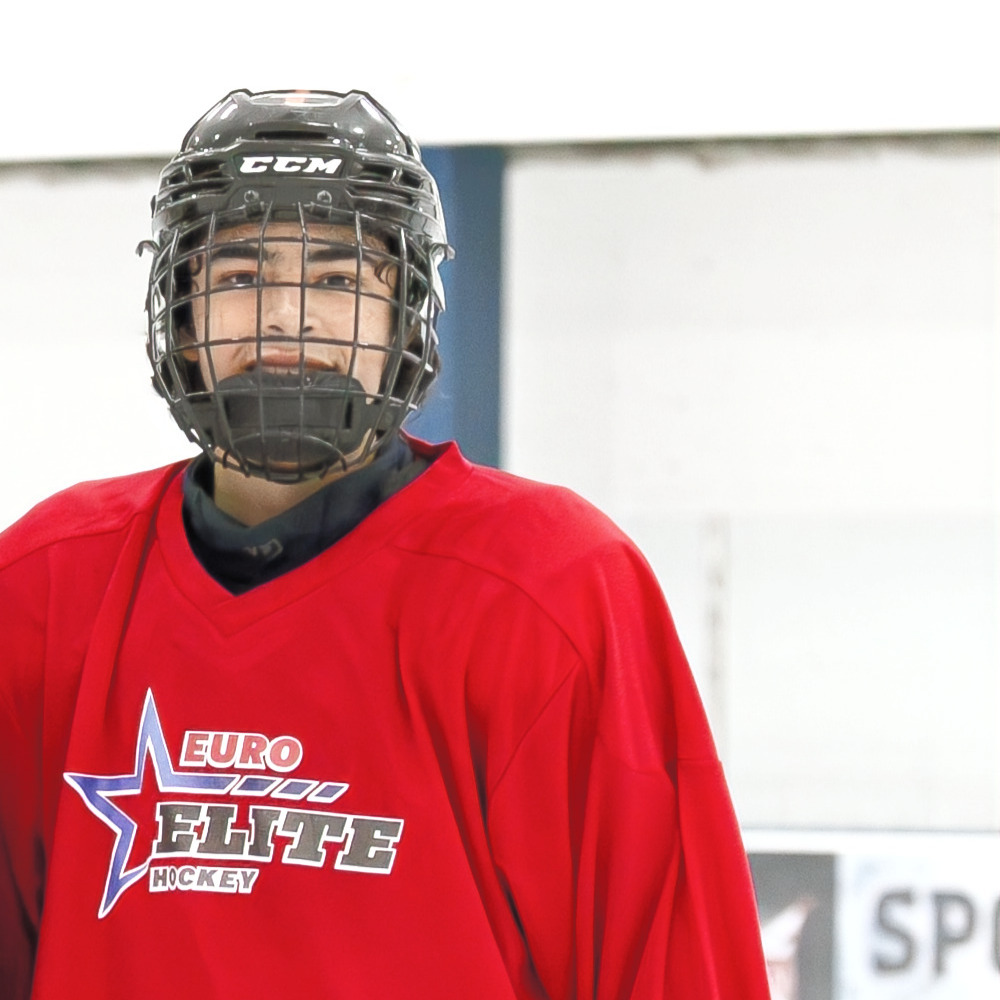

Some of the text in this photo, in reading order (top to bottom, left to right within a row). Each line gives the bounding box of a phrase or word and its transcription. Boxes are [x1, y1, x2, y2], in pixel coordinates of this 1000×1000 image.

[239, 155, 342, 174] CCM
[179, 730, 303, 772] EURO
[151, 801, 404, 875] ELITE
[149, 865, 259, 893] HOCKEY
[872, 886, 1000, 977] SP
